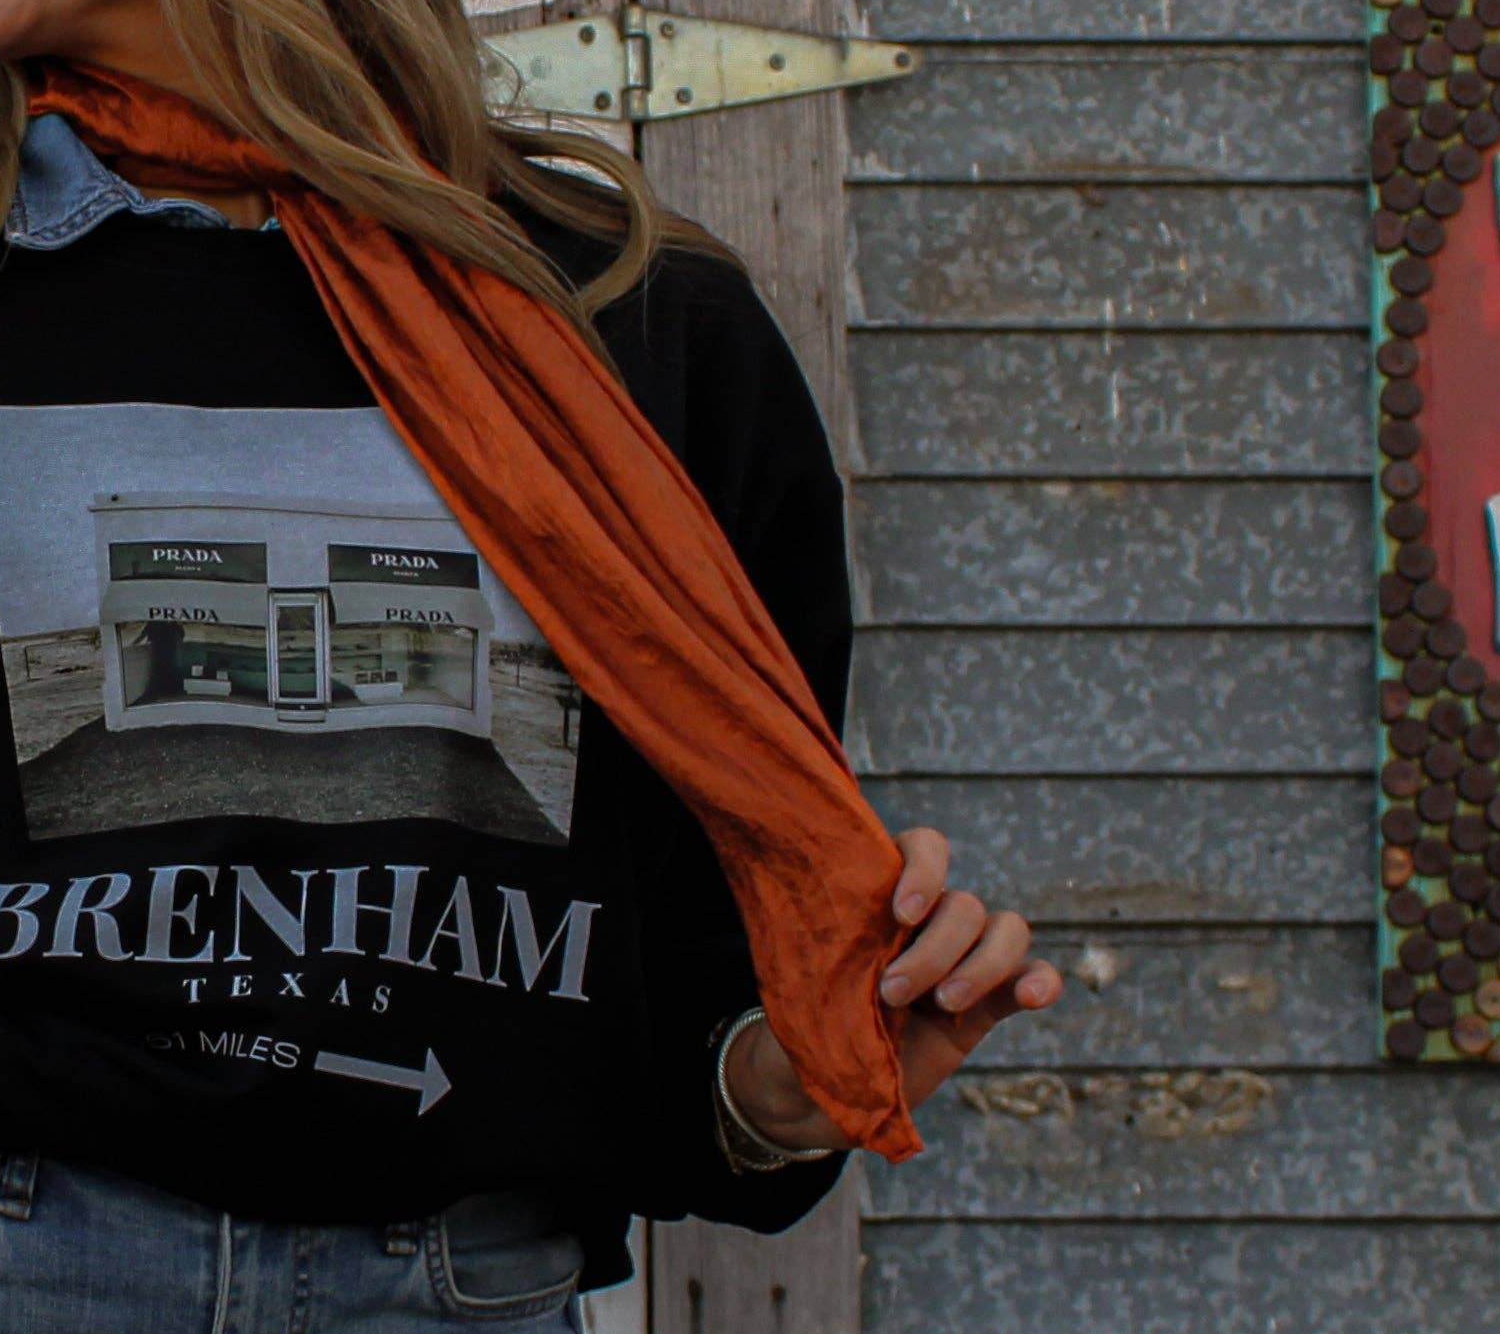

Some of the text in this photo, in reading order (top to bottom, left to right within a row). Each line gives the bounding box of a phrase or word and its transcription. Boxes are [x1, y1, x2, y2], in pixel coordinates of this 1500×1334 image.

[152, 548, 223, 563] PRADA
[371, 553, 439, 570] PRADA
[149, 607, 219, 622] PRADA
[386, 608, 455, 623] PRADA
[182, 971, 393, 1013] TEXAS
[199, 1030, 302, 1069] MILES
